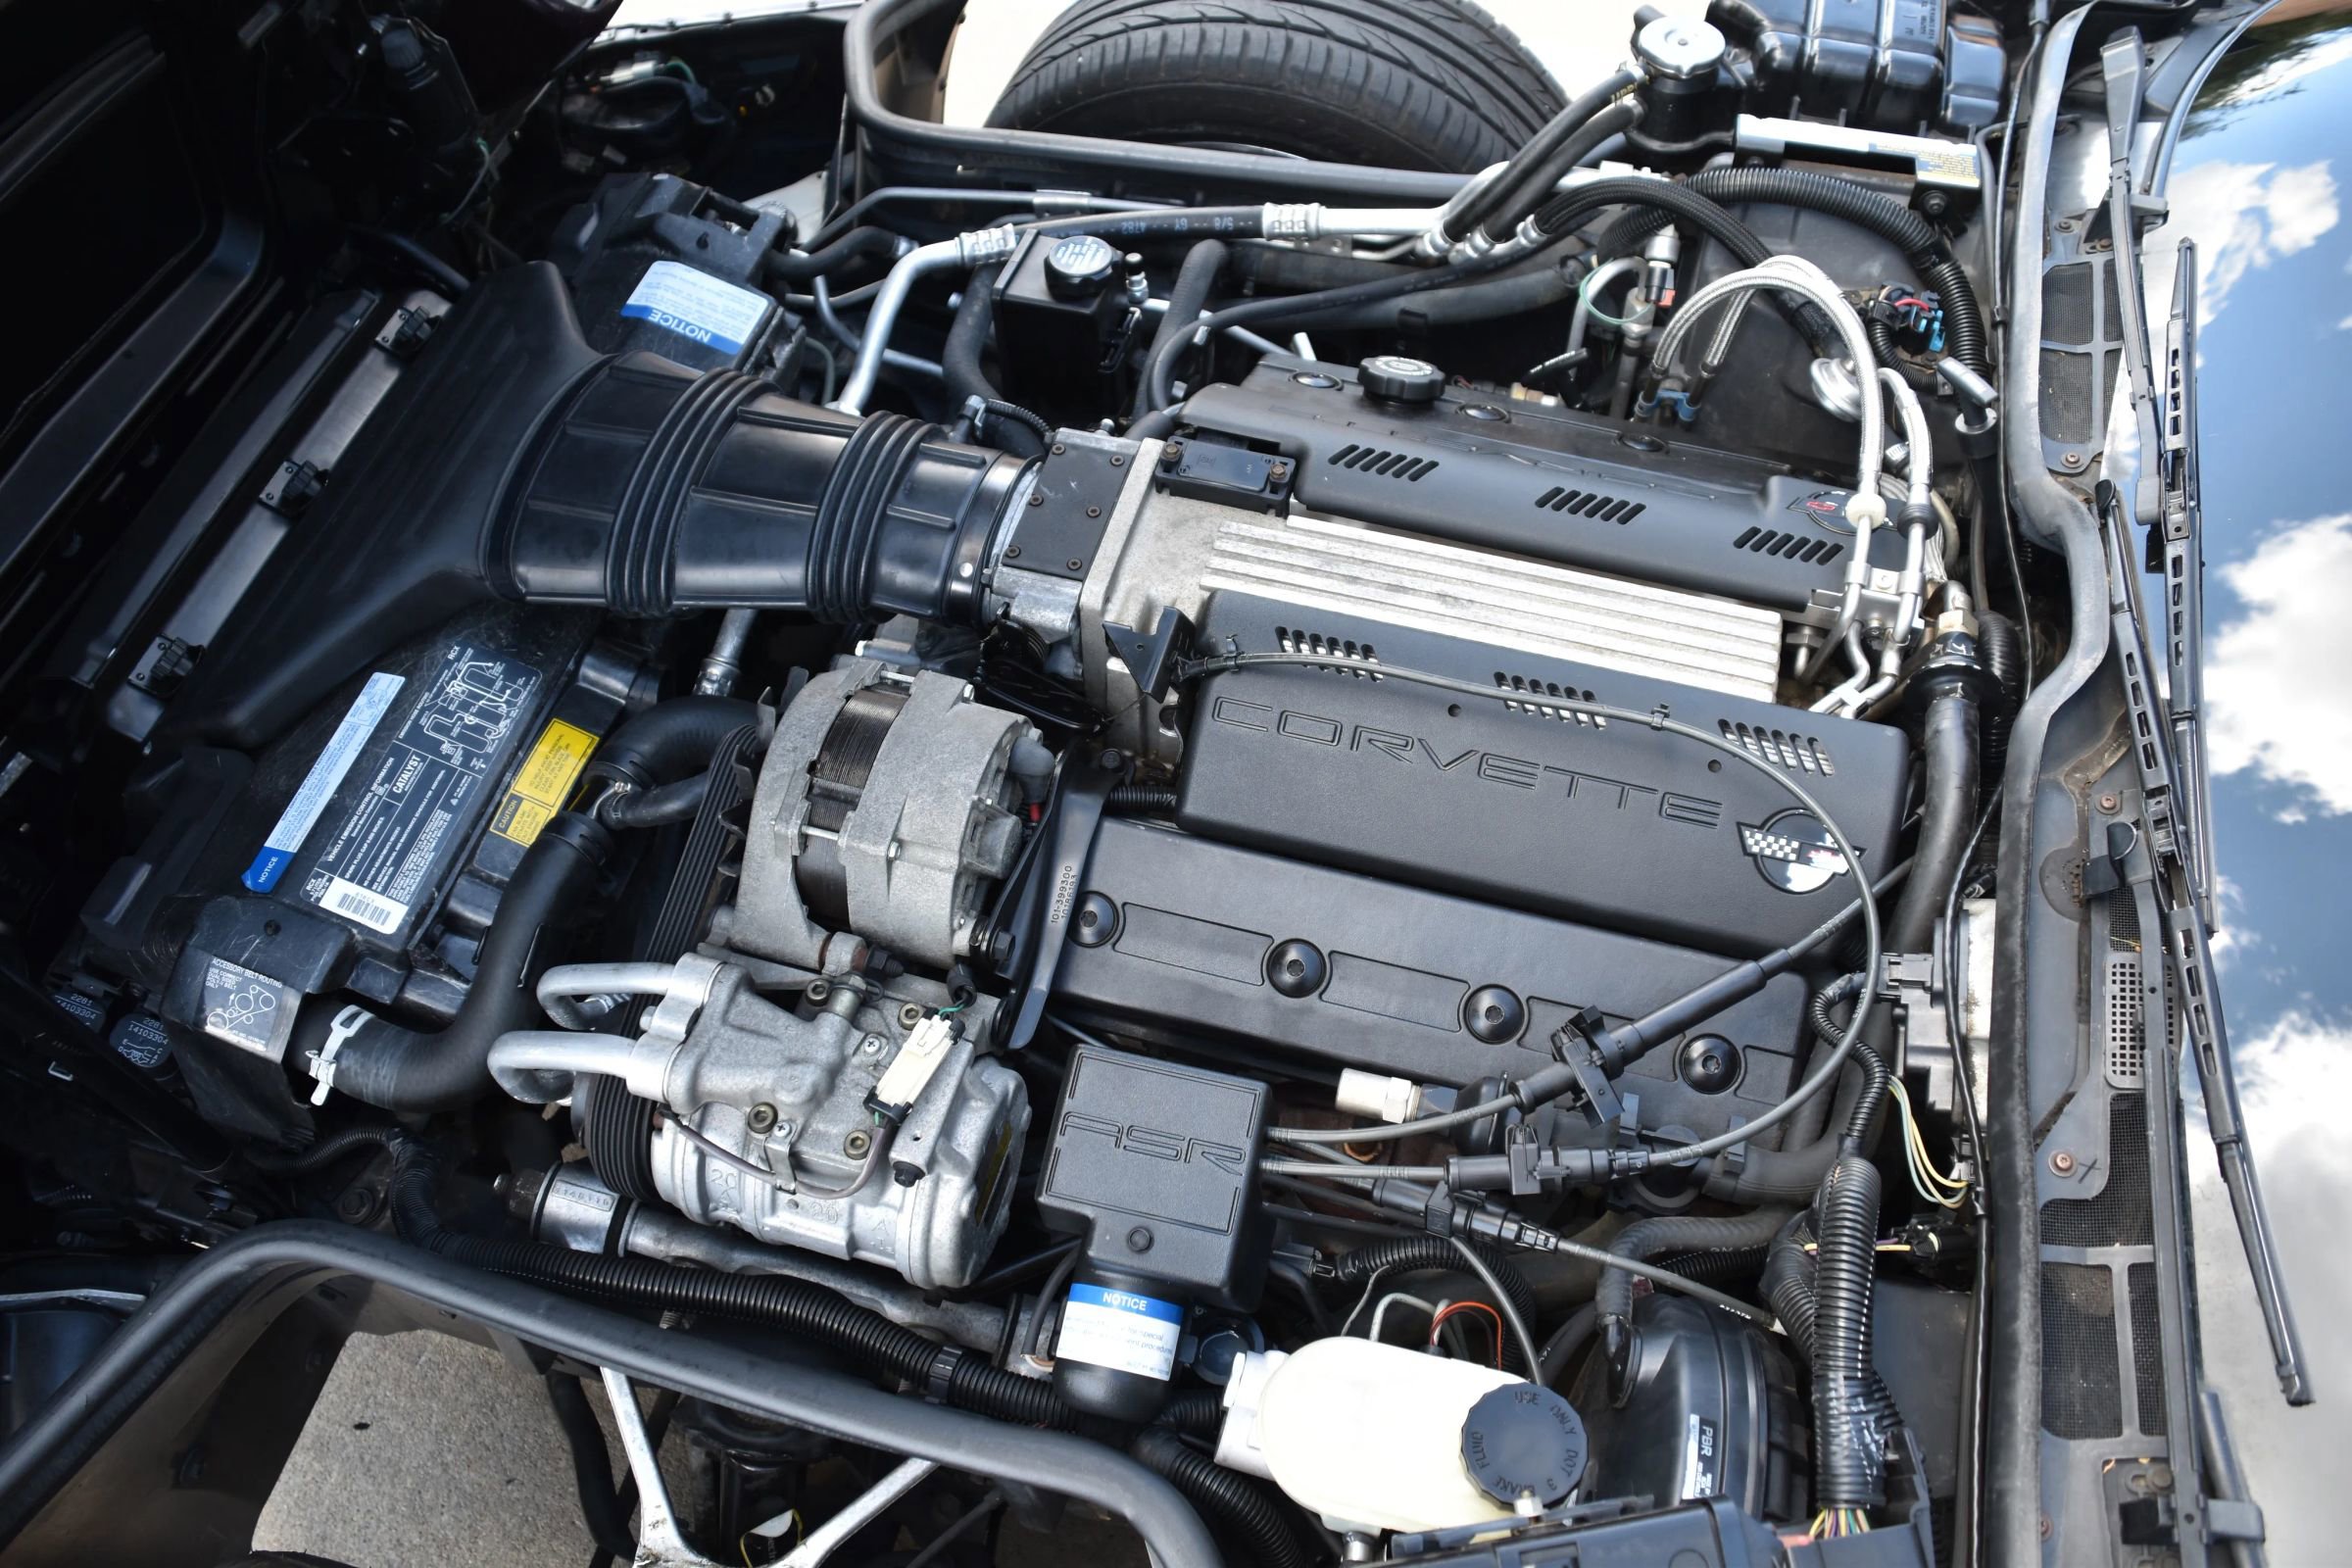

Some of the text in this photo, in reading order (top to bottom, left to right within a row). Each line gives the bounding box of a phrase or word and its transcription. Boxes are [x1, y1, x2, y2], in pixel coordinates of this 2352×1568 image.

[1119, 216, 1234, 233] 5/8 GY 4782
[645, 308, 712, 343] NOTICE
[446, 644, 461, 661] RCX
[391, 754, 421, 794] CATALYST
[1211, 696, 1723, 830] CORVETTE
[326, 756, 395, 862] VEHICLE EMISSION CONTROL INFORMATION
[358, 812, 368, 824] Motors
[497, 798, 518, 829] CAUTION
[257, 855, 279, 884] NOTICE
[343, 863, 356, 879] SPARK
[352, 851, 363, 864] PLUG
[305, 877, 316, 891] RCX
[1050, 864, 1072, 924] 101-399300
[204, 980, 219, 989] ONLY
[211, 957, 283, 989] ACCESSORY BELT ROUTING
[71, 994, 93, 1004] 2281
[127, 1024, 169, 1045] 14103304
[142, 1017, 165, 1029] 2281
[1059, 1110, 1247, 1177] ASR
[1102, 1292, 1148, 1310] NOTICE
[1514, 1391, 1541, 1404] USE
[1549, 1404, 1577, 1435] ONLY
[1471, 1431, 1491, 1469] FLUID
[1698, 1425, 1714, 1457] PBR
[1559, 1448, 1579, 1477] DOT
[1546, 1478, 1558, 1491] 3
